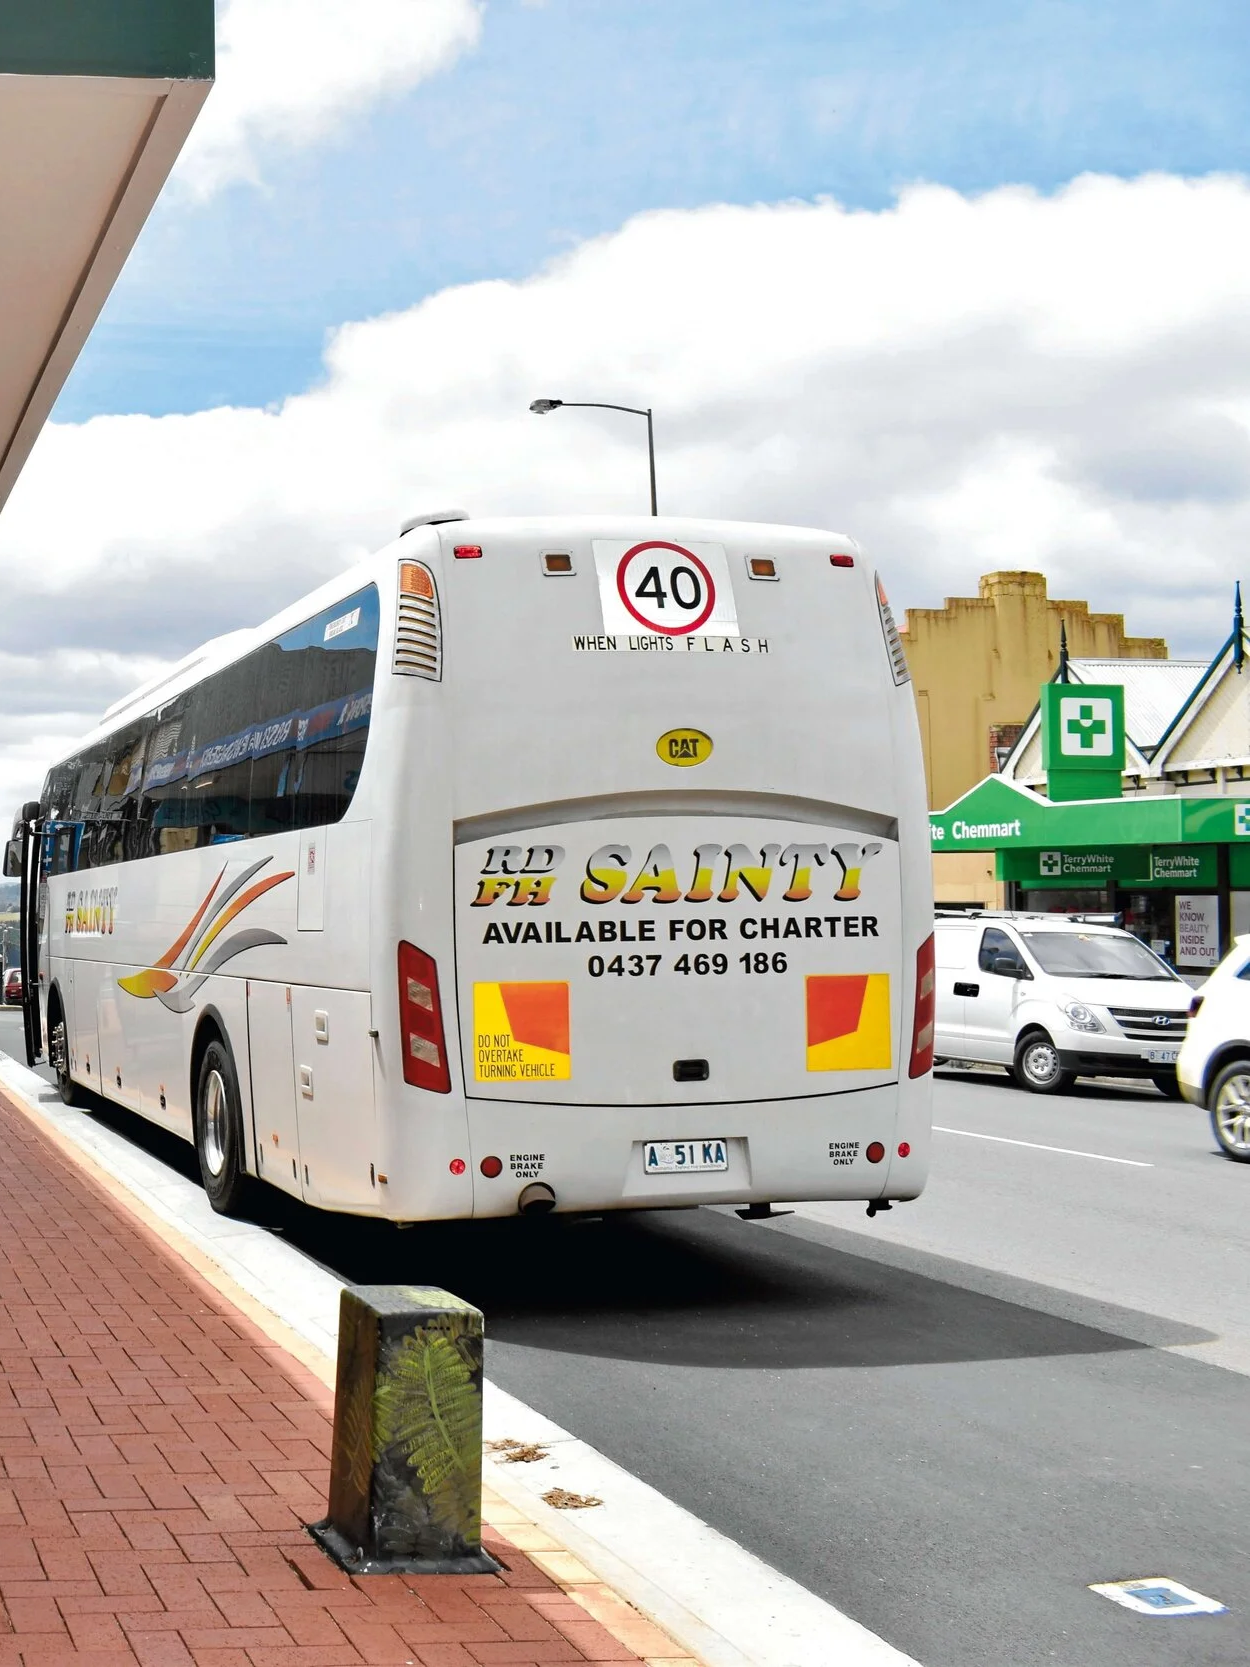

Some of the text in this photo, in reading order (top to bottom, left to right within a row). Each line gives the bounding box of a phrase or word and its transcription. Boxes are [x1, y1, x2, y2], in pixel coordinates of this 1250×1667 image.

[635, 566, 702, 610] 40
[574, 635, 617, 651] WHEN
[629, 635, 674, 651] LIGHTS
[668, 738, 700, 758] CAT
[952, 819, 1021, 839] Chemmart
[1063, 855, 1114, 865] TerryWhite
[1154, 856, 1199, 869] TerryWhite
[580, 842, 883, 907] SAINTY
[1063, 864, 1111, 874] Chemmart
[1154, 867, 1197, 878] Chemmart
[1179, 901, 1191, 910] WE
[1179, 913, 1204, 921] KNOW
[482, 916, 879, 944] AVAILABLE FOR CHARTER
[1179, 924, 1209, 933] BEAUTY
[1180, 935, 1205, 945] INSIDE
[1180, 947, 1216, 956] AND OUT
[588, 952, 788, 978] 0437 469 186
[478, 1034, 511, 1047] DO NOT
[478, 1049, 524, 1063] OVERTAKE
[479, 1063, 555, 1078] TURNING VEHICLE
[648, 1143, 725, 1166] A 51 KA
[510, 1162, 543, 1170] BRAKE
